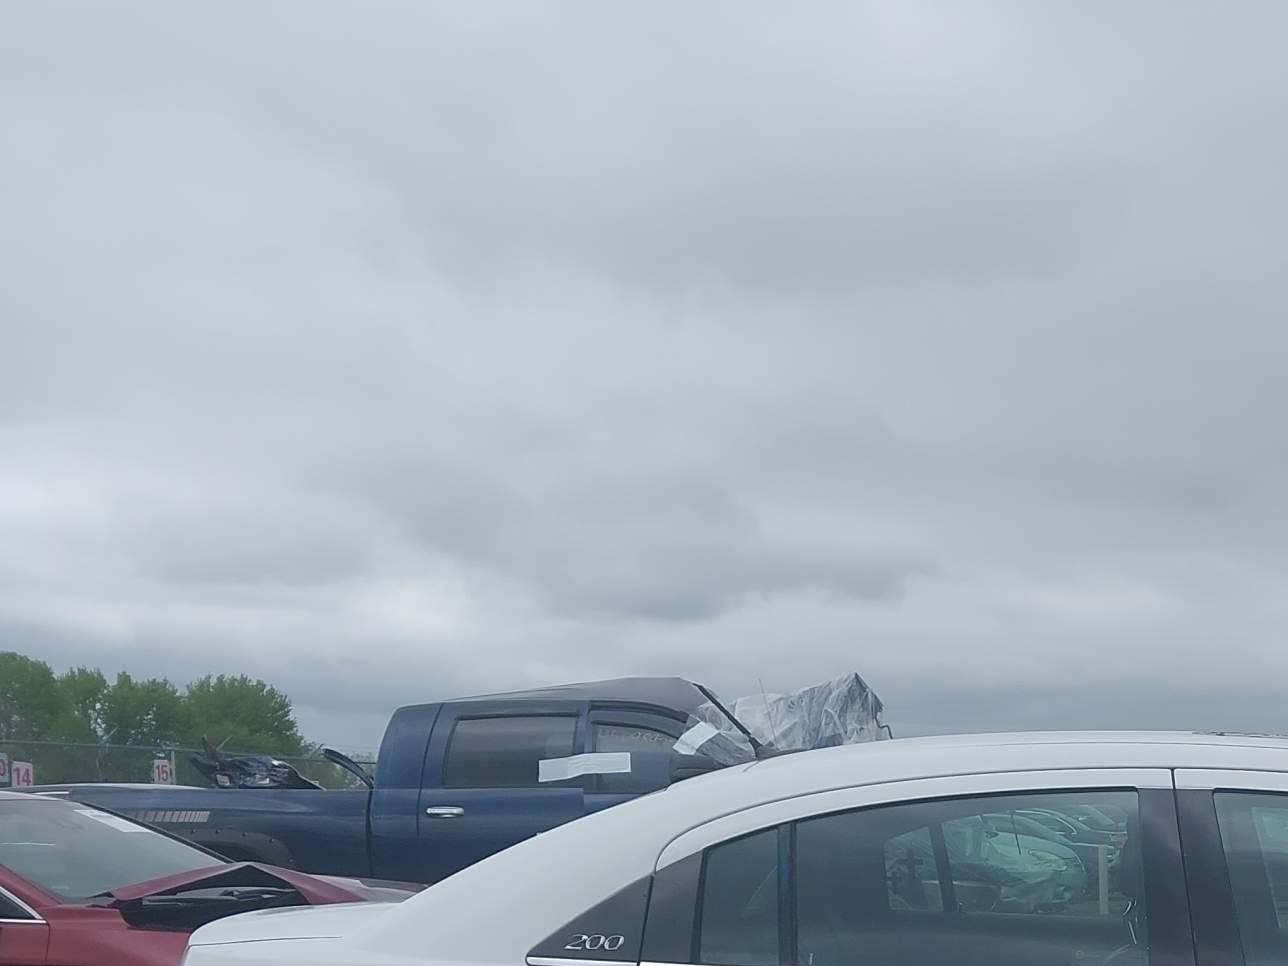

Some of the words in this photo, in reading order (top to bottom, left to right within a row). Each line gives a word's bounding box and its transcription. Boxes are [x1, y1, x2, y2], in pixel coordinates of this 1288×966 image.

[13, 767, 32, 786] 14
[155, 764, 169, 782] 15
[564, 933, 625, 951] 200
